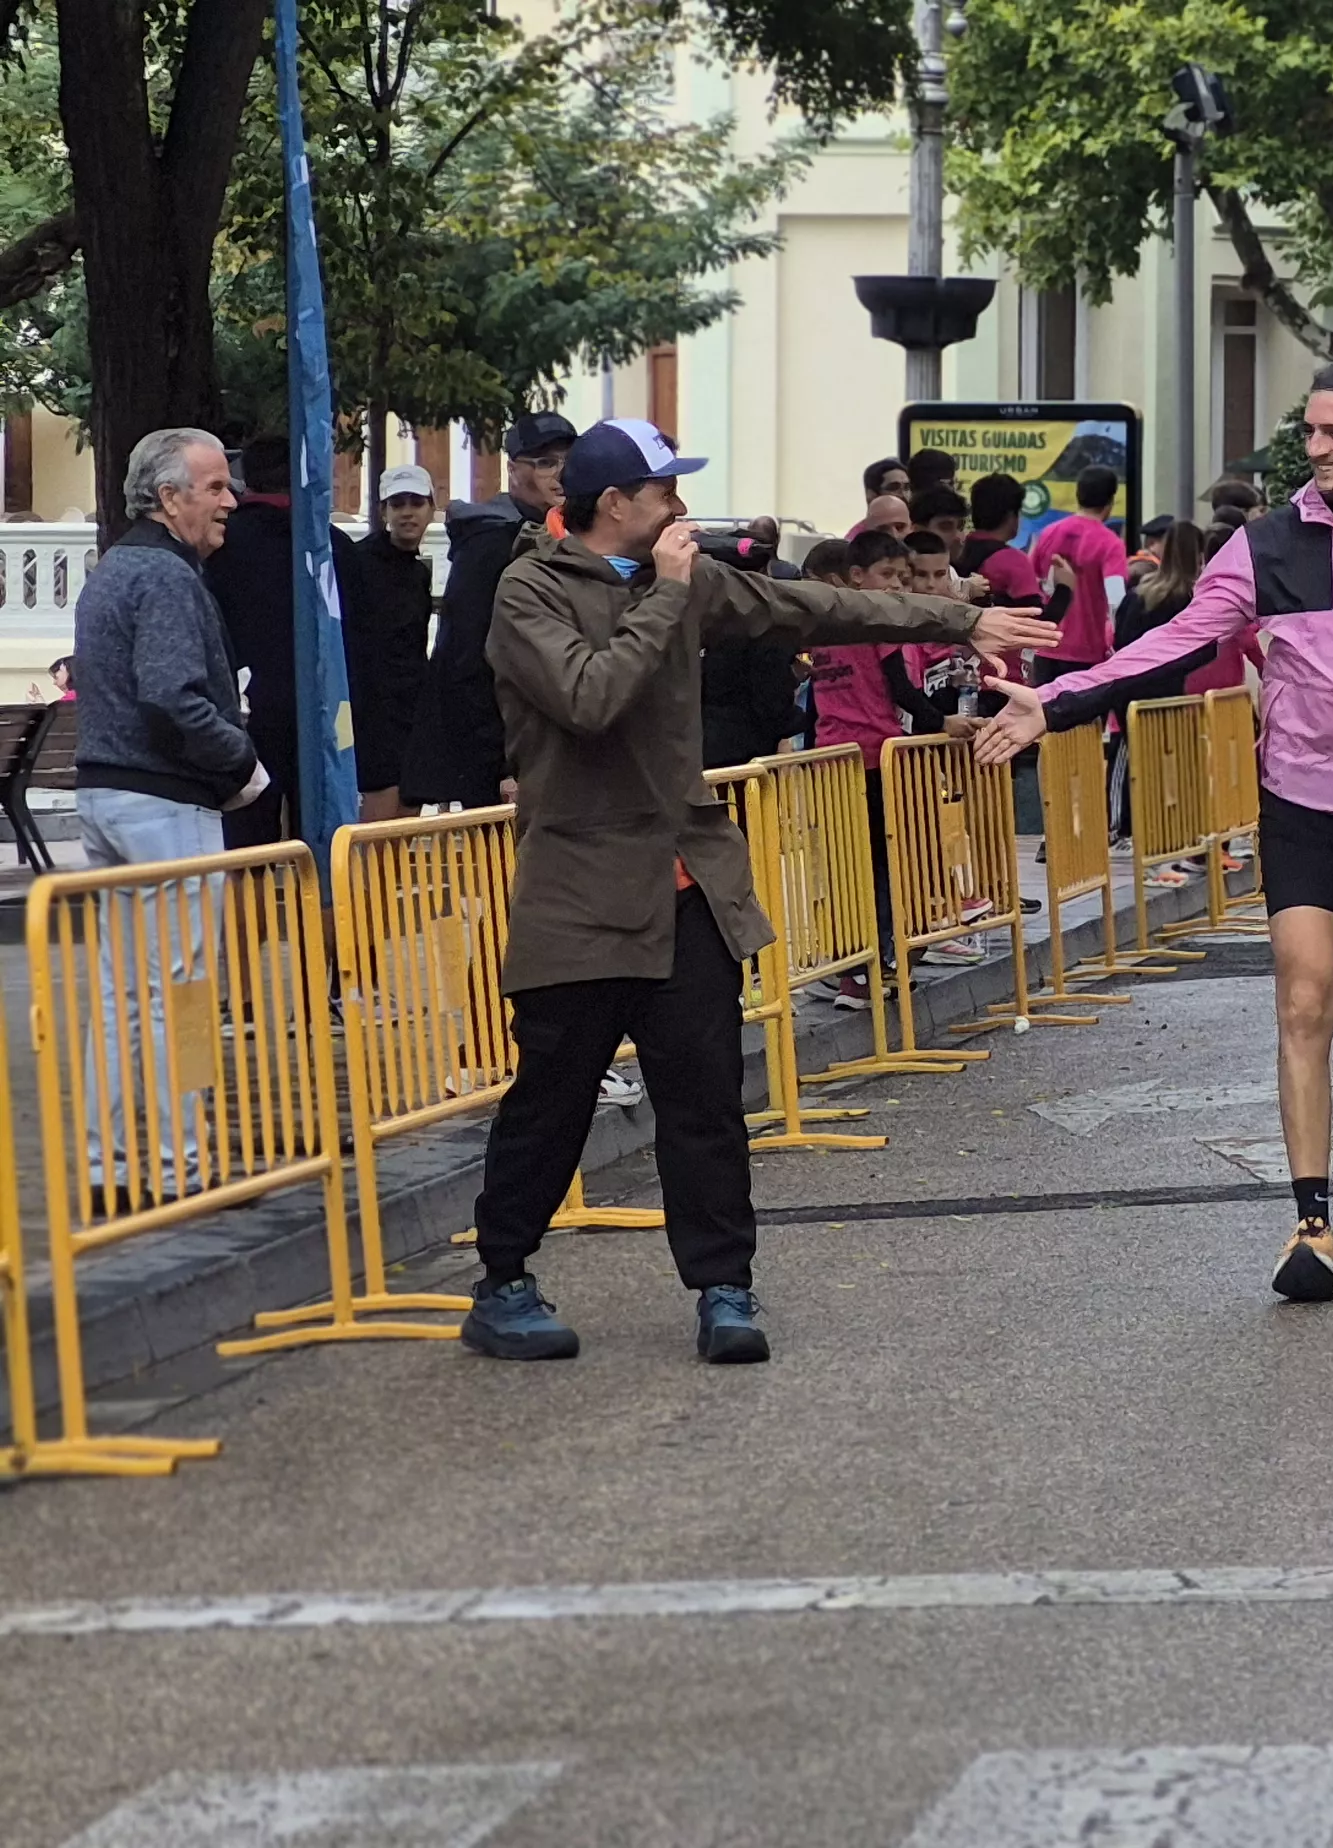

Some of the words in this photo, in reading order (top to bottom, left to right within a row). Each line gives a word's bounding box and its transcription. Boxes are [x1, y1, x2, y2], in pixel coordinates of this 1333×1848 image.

[920, 429, 976, 447] VISITAS
[982, 431, 1047, 449] GUIADAS
[952, 453, 1026, 472] OTURISMO
